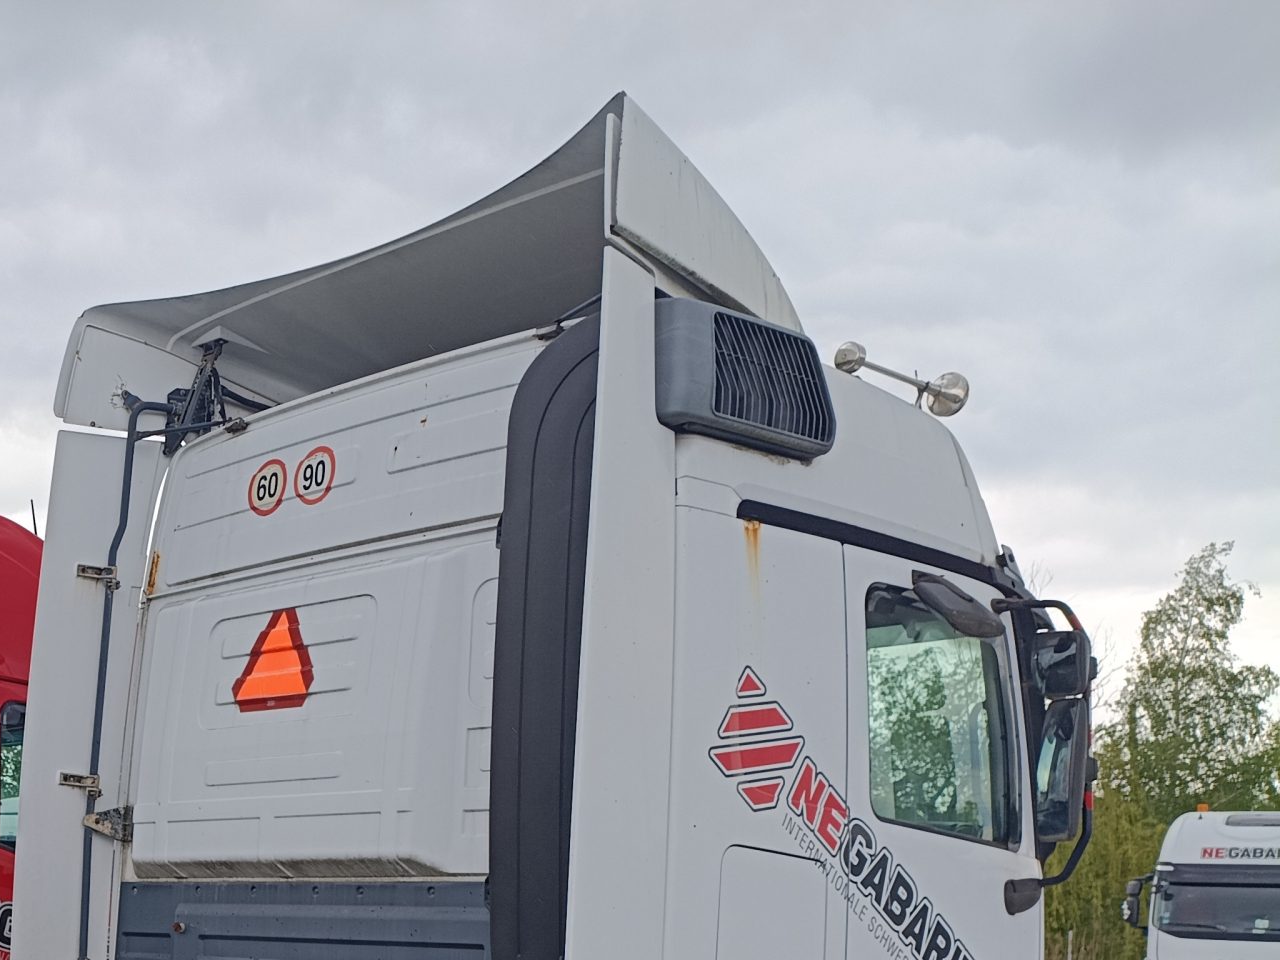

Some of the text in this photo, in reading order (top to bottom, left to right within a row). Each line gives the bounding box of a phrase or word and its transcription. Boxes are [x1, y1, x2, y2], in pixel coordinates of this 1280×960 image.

[257, 472, 278, 501] 60
[303, 460, 326, 490] 90
[781, 813, 869, 922] INTERNATIONALE
